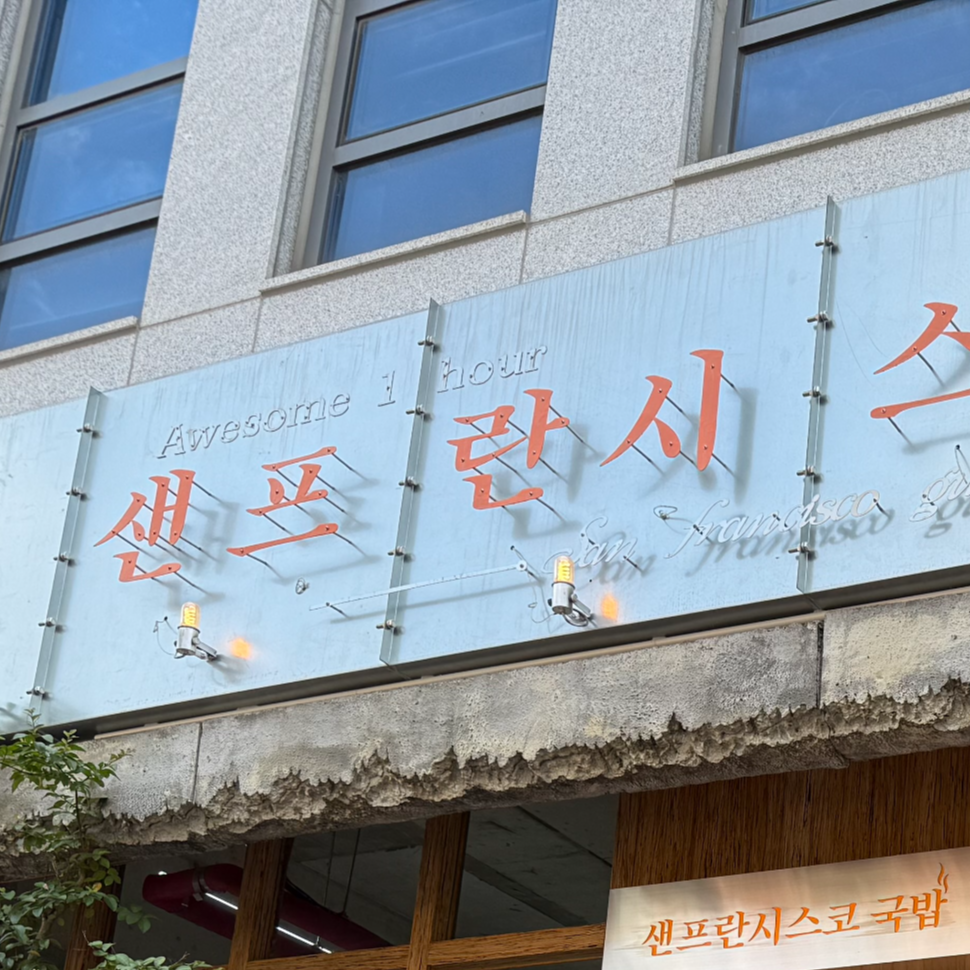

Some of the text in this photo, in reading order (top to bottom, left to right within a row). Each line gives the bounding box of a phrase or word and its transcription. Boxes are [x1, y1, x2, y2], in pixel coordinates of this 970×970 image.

[156, 391, 351, 459] Awesome
[435, 345, 548, 393] hour
[642, 887, 948, 957] 샌프란시스코 국밥
